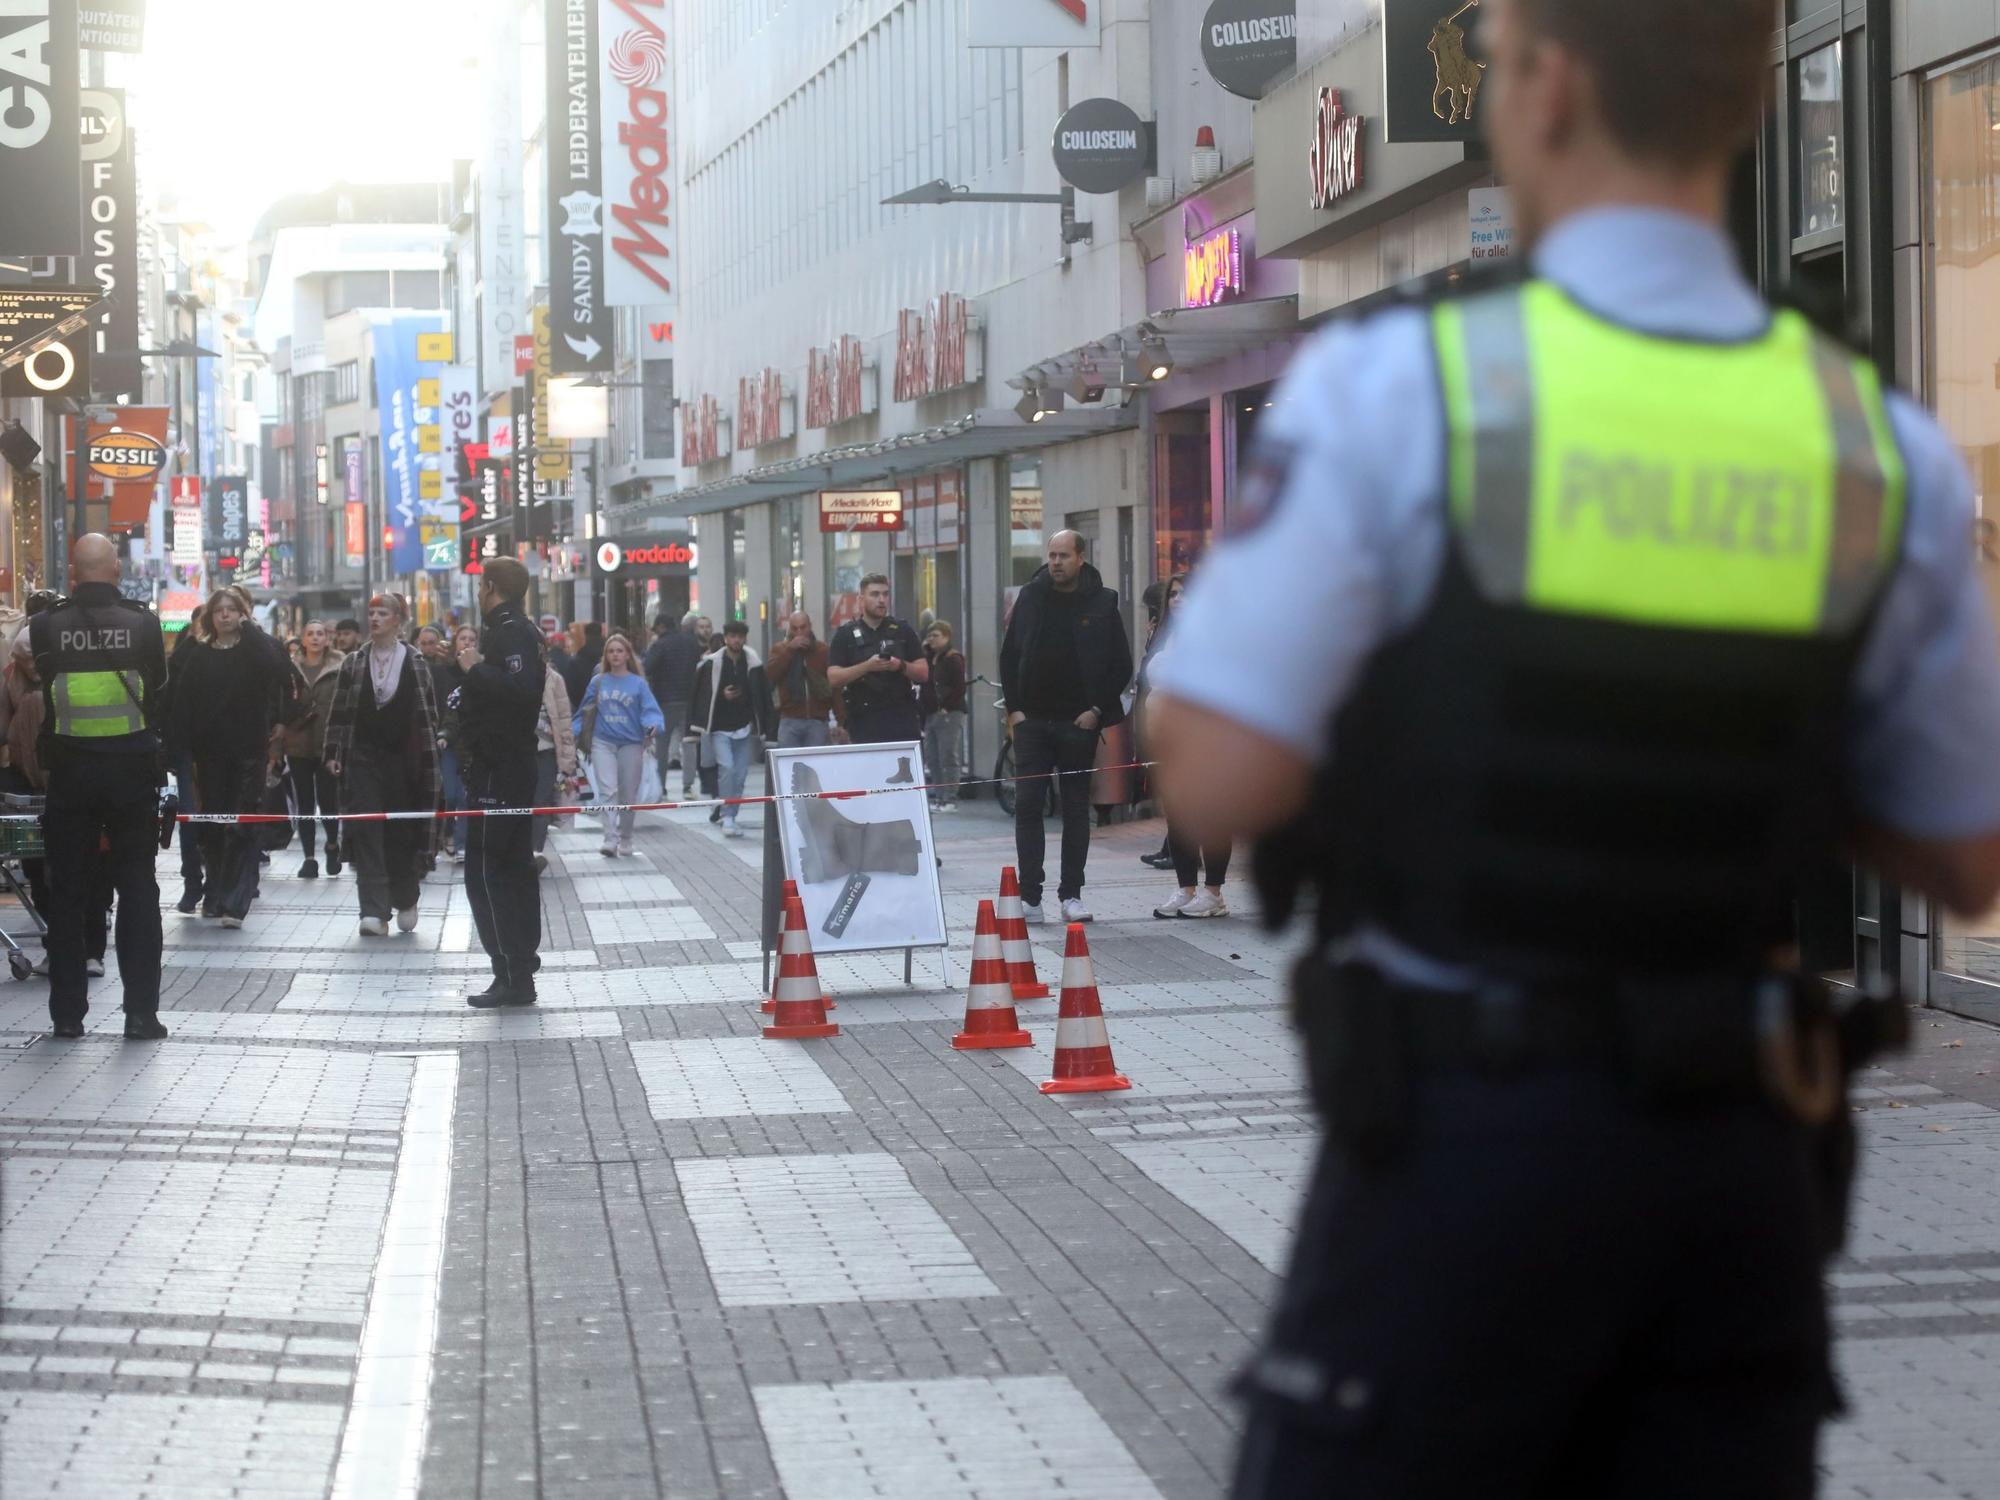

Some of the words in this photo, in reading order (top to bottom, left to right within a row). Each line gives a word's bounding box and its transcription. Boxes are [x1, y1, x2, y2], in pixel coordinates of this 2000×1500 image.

[1061, 129, 1137, 150] COLLOSEUM
[1309, 86, 1359, 209] s.Oliver
[1472, 231, 1492, 243] Free
[1496, 228, 1513, 241] Wi
[1472, 246, 1486, 259] für
[572, 240, 593, 323] SANDY
[89, 447, 158, 465] FOSSIL
[1556, 448, 1812, 560] POLIZEI
[828, 513, 878, 525] EINGANG
[61, 628, 132, 652] POLIZEI
